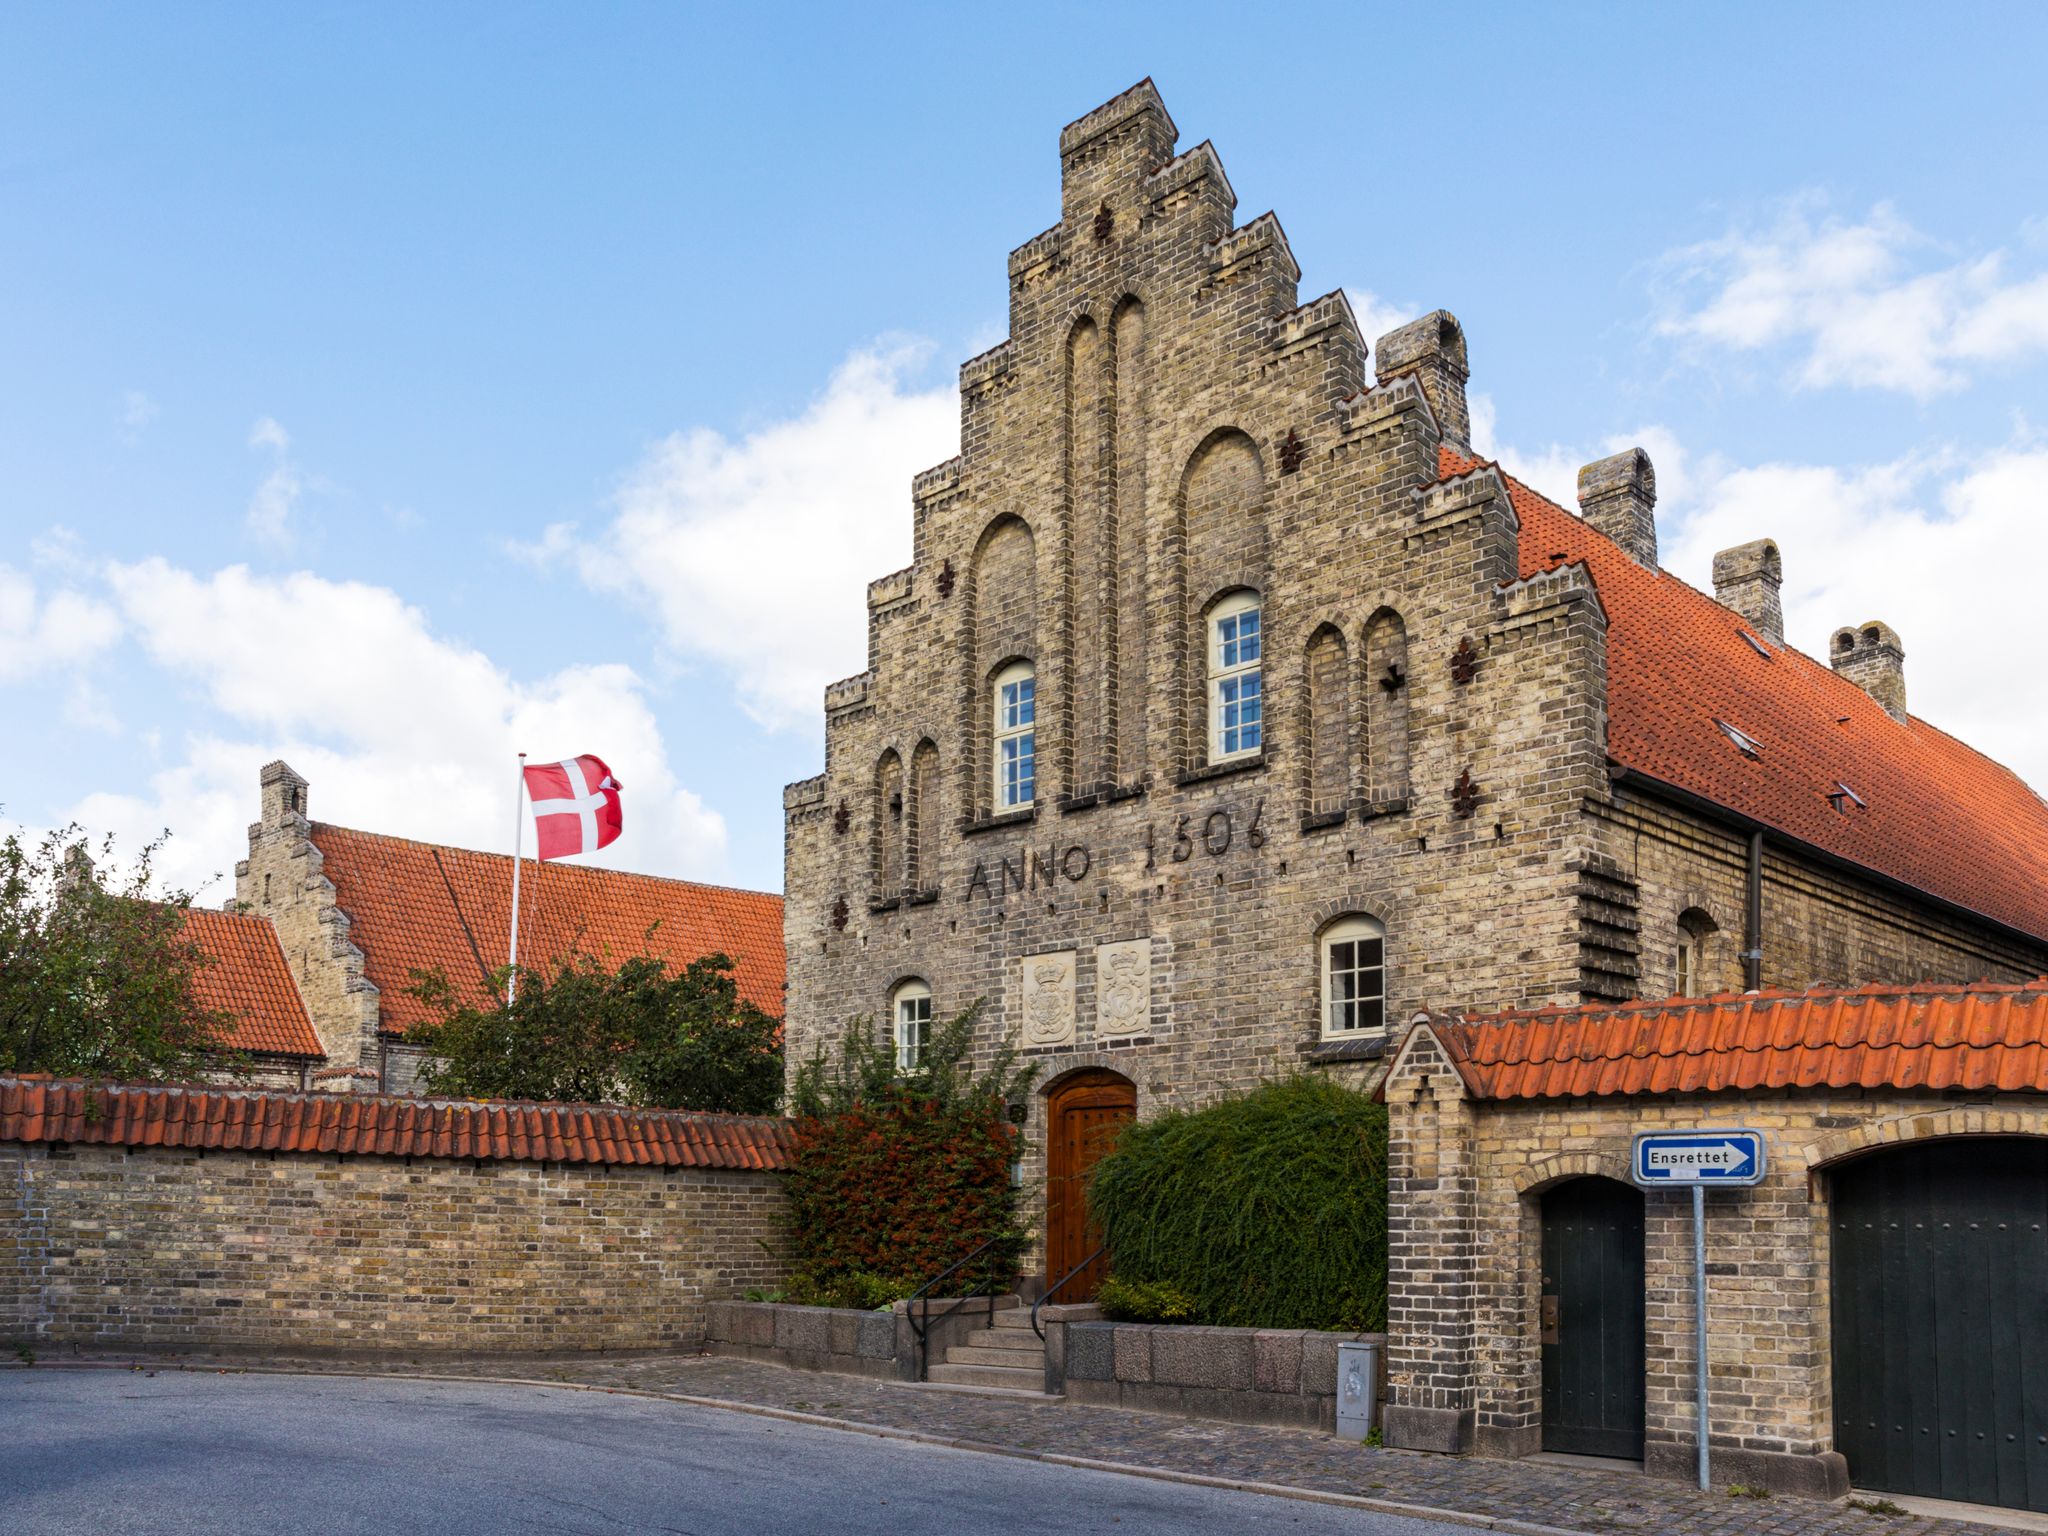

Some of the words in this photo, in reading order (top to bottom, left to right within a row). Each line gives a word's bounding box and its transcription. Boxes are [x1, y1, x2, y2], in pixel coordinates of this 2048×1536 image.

[967, 843, 1090, 901] ANNO
[1144, 800, 1265, 870] 1506
[1651, 1151, 1729, 1164] Ensrettet
